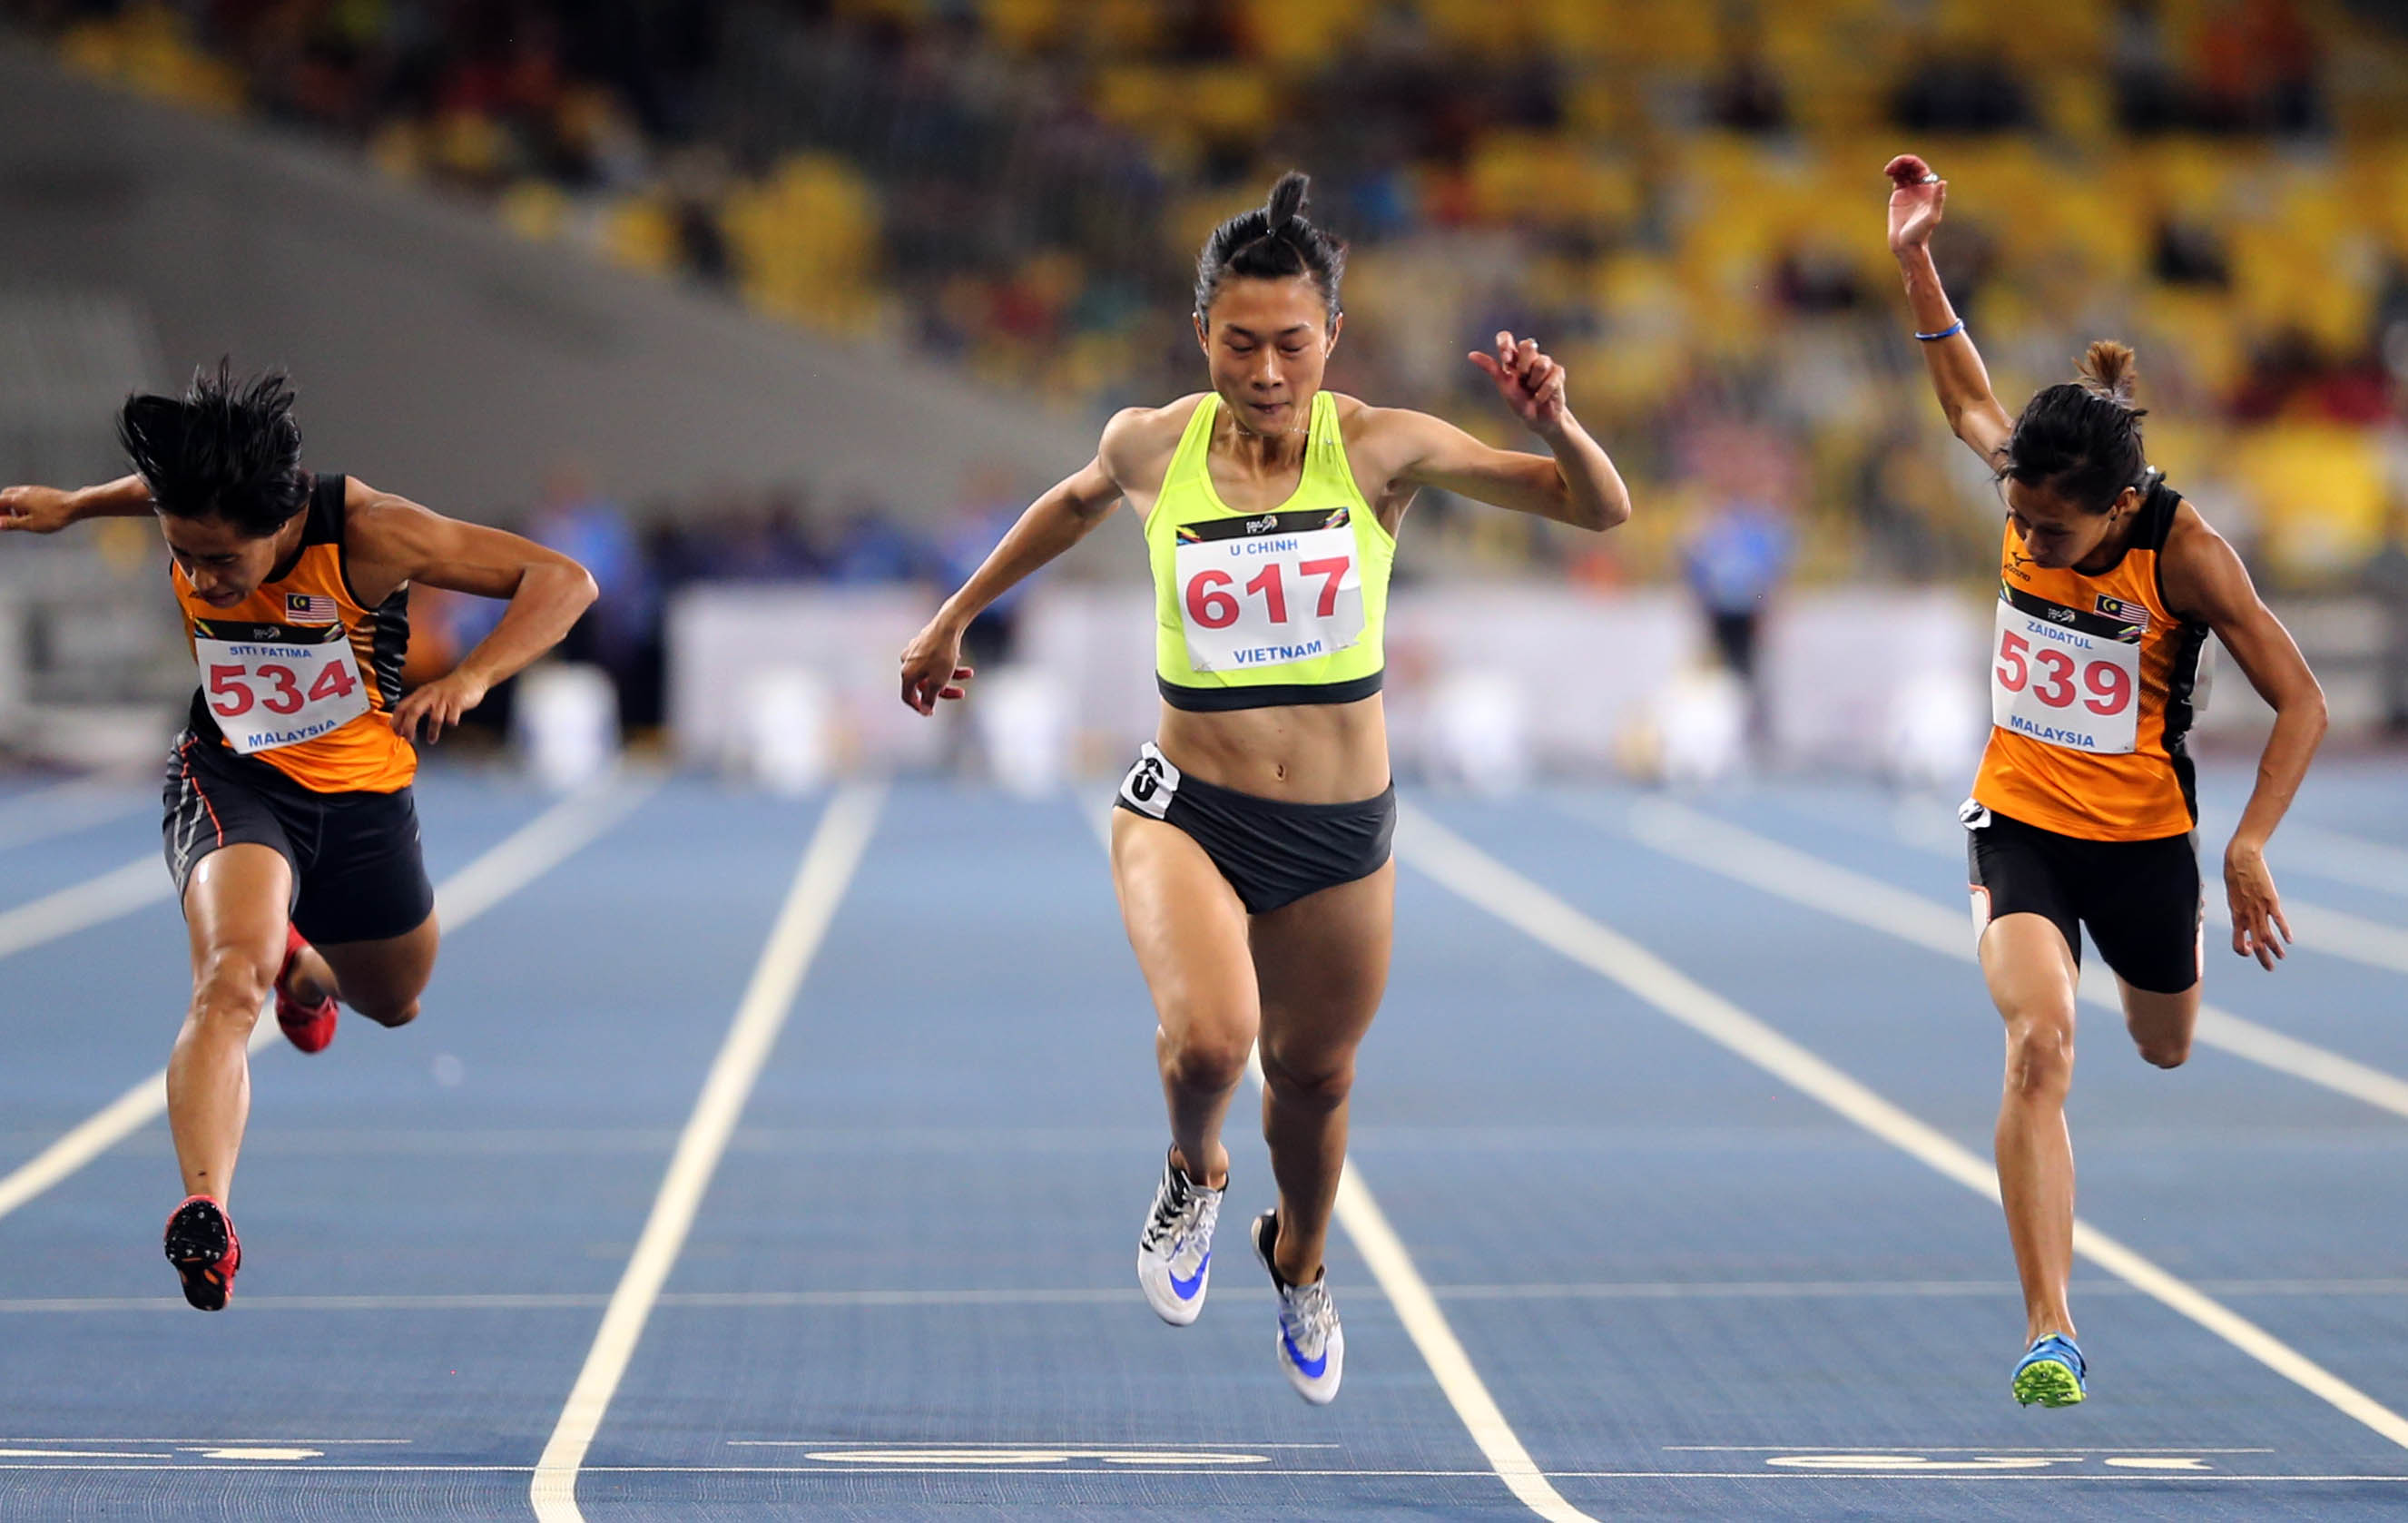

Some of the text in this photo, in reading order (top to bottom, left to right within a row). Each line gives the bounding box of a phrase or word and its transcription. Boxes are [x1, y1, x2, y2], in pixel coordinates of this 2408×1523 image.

[1229, 539, 1299, 556] U CHINH
[1185, 555, 1351, 629] 617
[2026, 621, 2094, 650] ZAIDATUL
[230, 645, 312, 658] SITI FATIMA
[1233, 640, 1322, 663] VIETNAM
[1996, 629, 2131, 715] 539
[210, 659, 357, 717] 534
[248, 719, 337, 748] MALAYSIA
[2010, 714, 2095, 747] MALAYSIA
